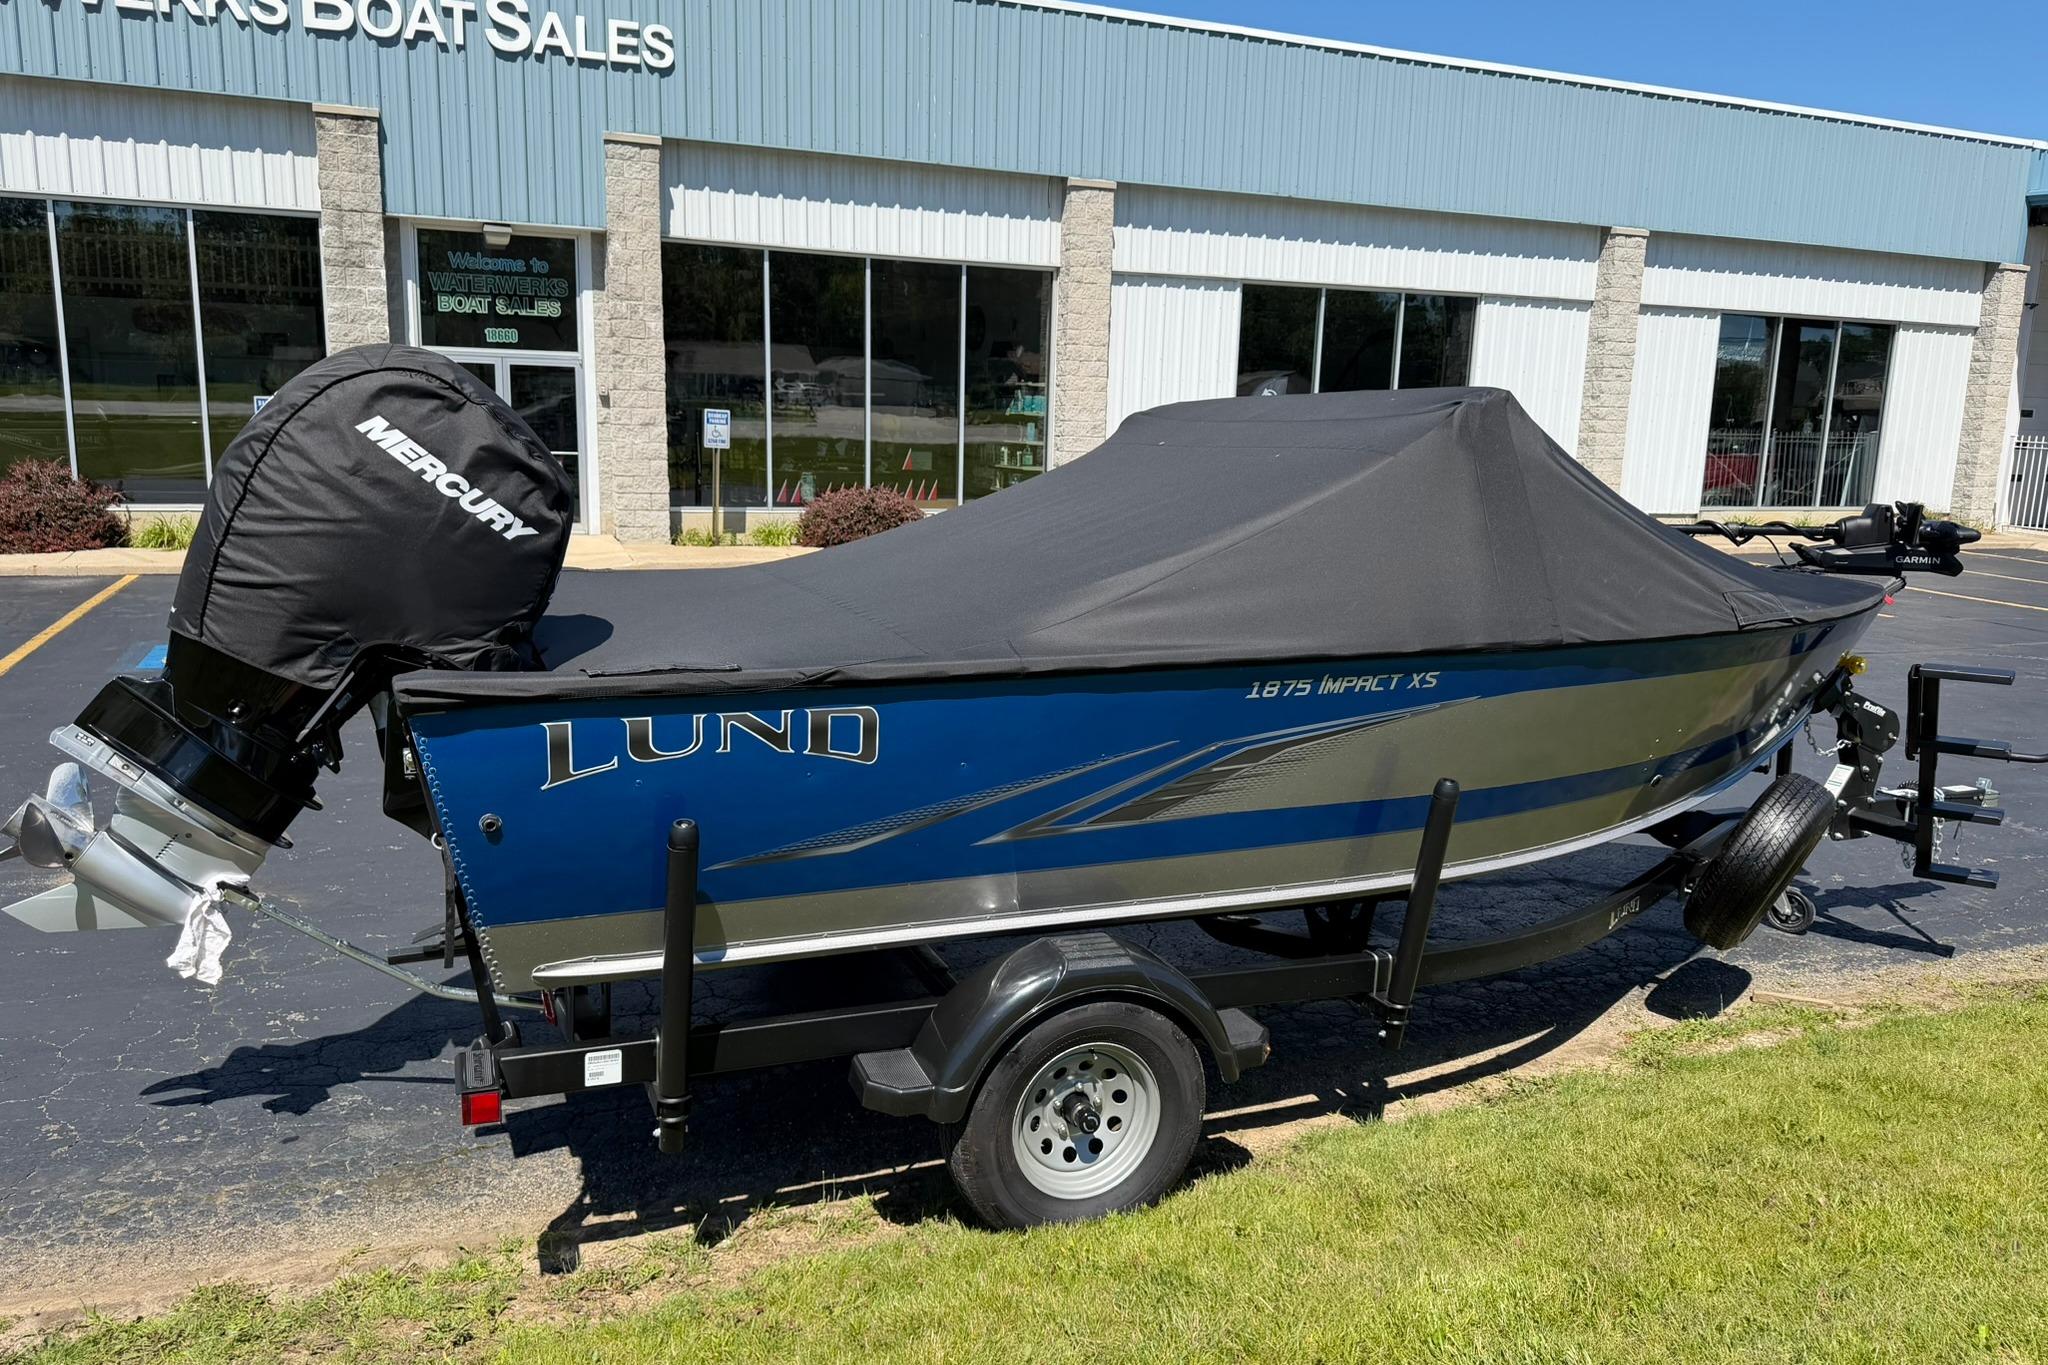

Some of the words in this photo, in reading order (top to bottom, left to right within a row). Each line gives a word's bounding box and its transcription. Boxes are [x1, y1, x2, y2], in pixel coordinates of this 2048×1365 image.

[302, 0, 475, 46] BOAT
[485, 0, 675, 68] SALES
[448, 251, 527, 272] Welcome
[531, 257, 549, 274] to
[428, 271, 569, 297] WATERWERKS
[437, 293, 491, 314] BOAT
[496, 296, 562, 317] SALES
[484, 327, 518, 343] 18660
[355, 415, 539, 540] MERCURY
[1895, 555, 1941, 565] GARMIN
[1245, 678, 1314, 699] 1875
[1318, 674, 1405, 695] IMPACT
[1407, 671, 1441, 689] XS
[540, 706, 880, 791] LUND
